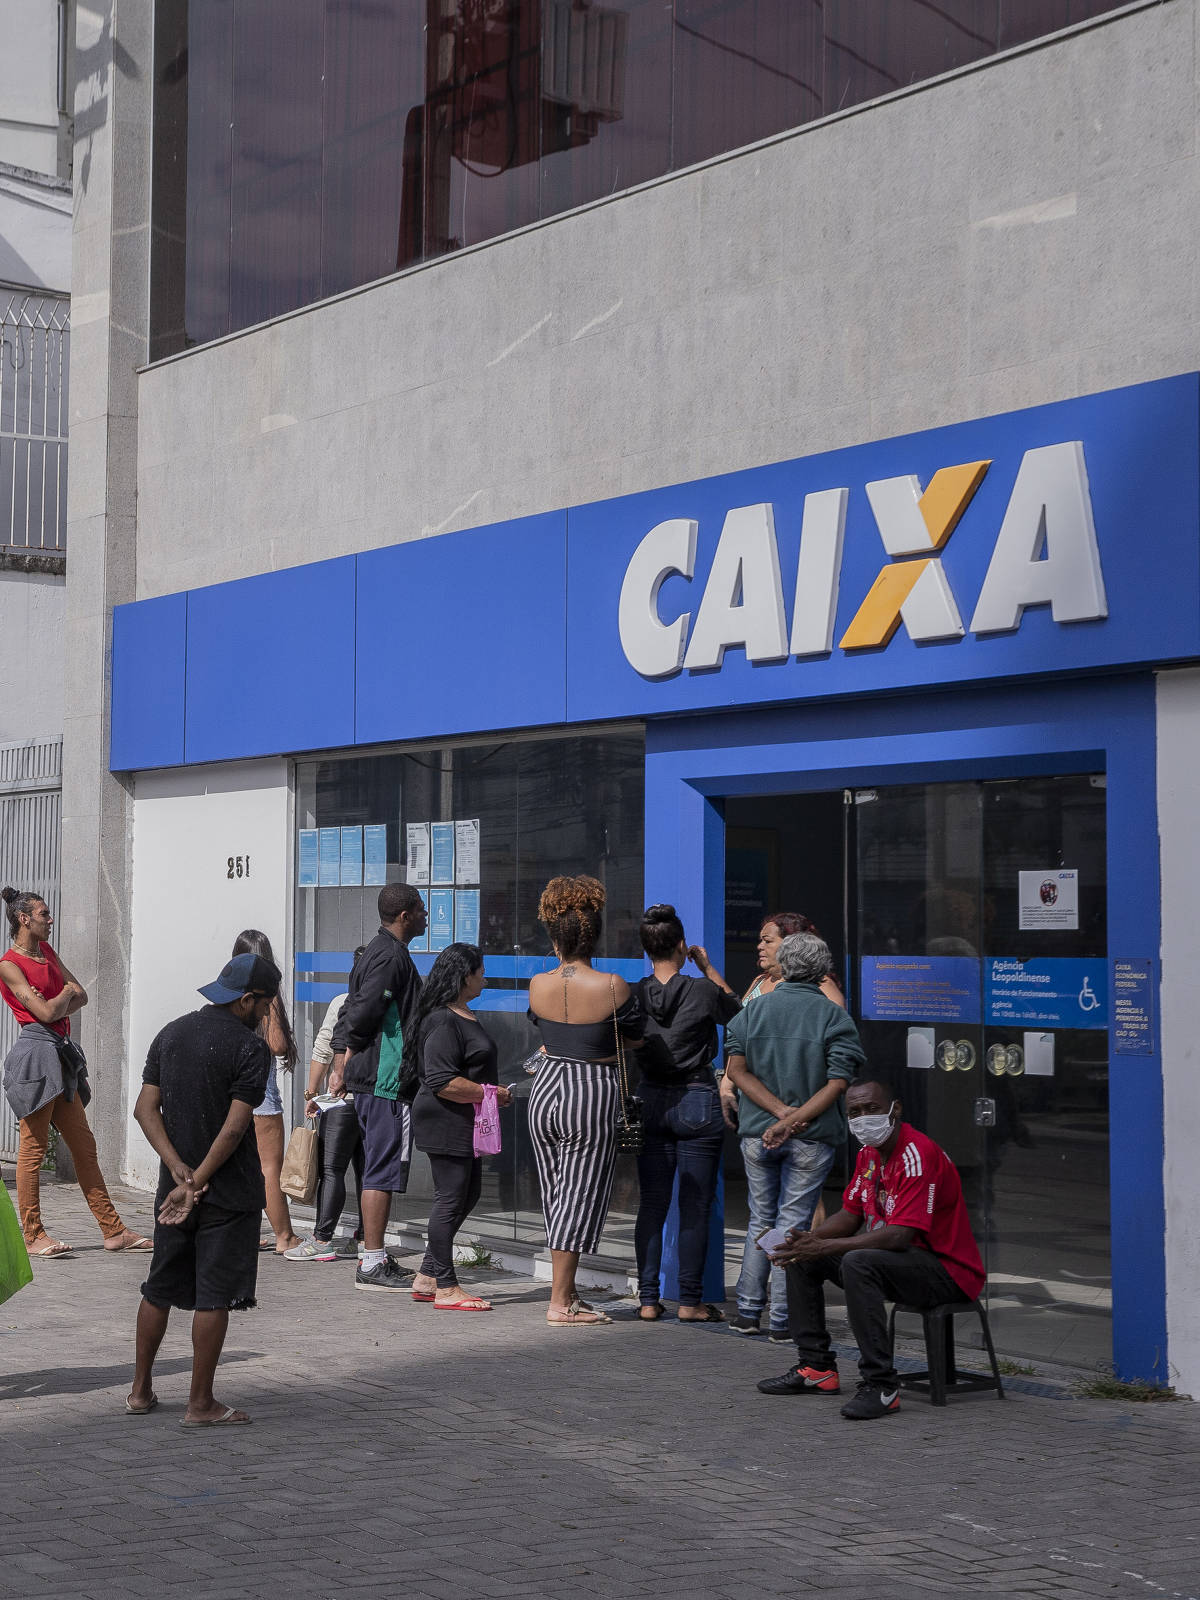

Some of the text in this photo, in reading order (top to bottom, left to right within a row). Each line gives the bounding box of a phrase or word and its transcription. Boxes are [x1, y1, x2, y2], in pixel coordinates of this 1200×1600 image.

[618, 440, 1108, 677] CAIXA
[226, 855, 251, 880] 251
[992, 960, 1024, 972] Agência
[992, 971, 1051, 984] Leopoldinense
